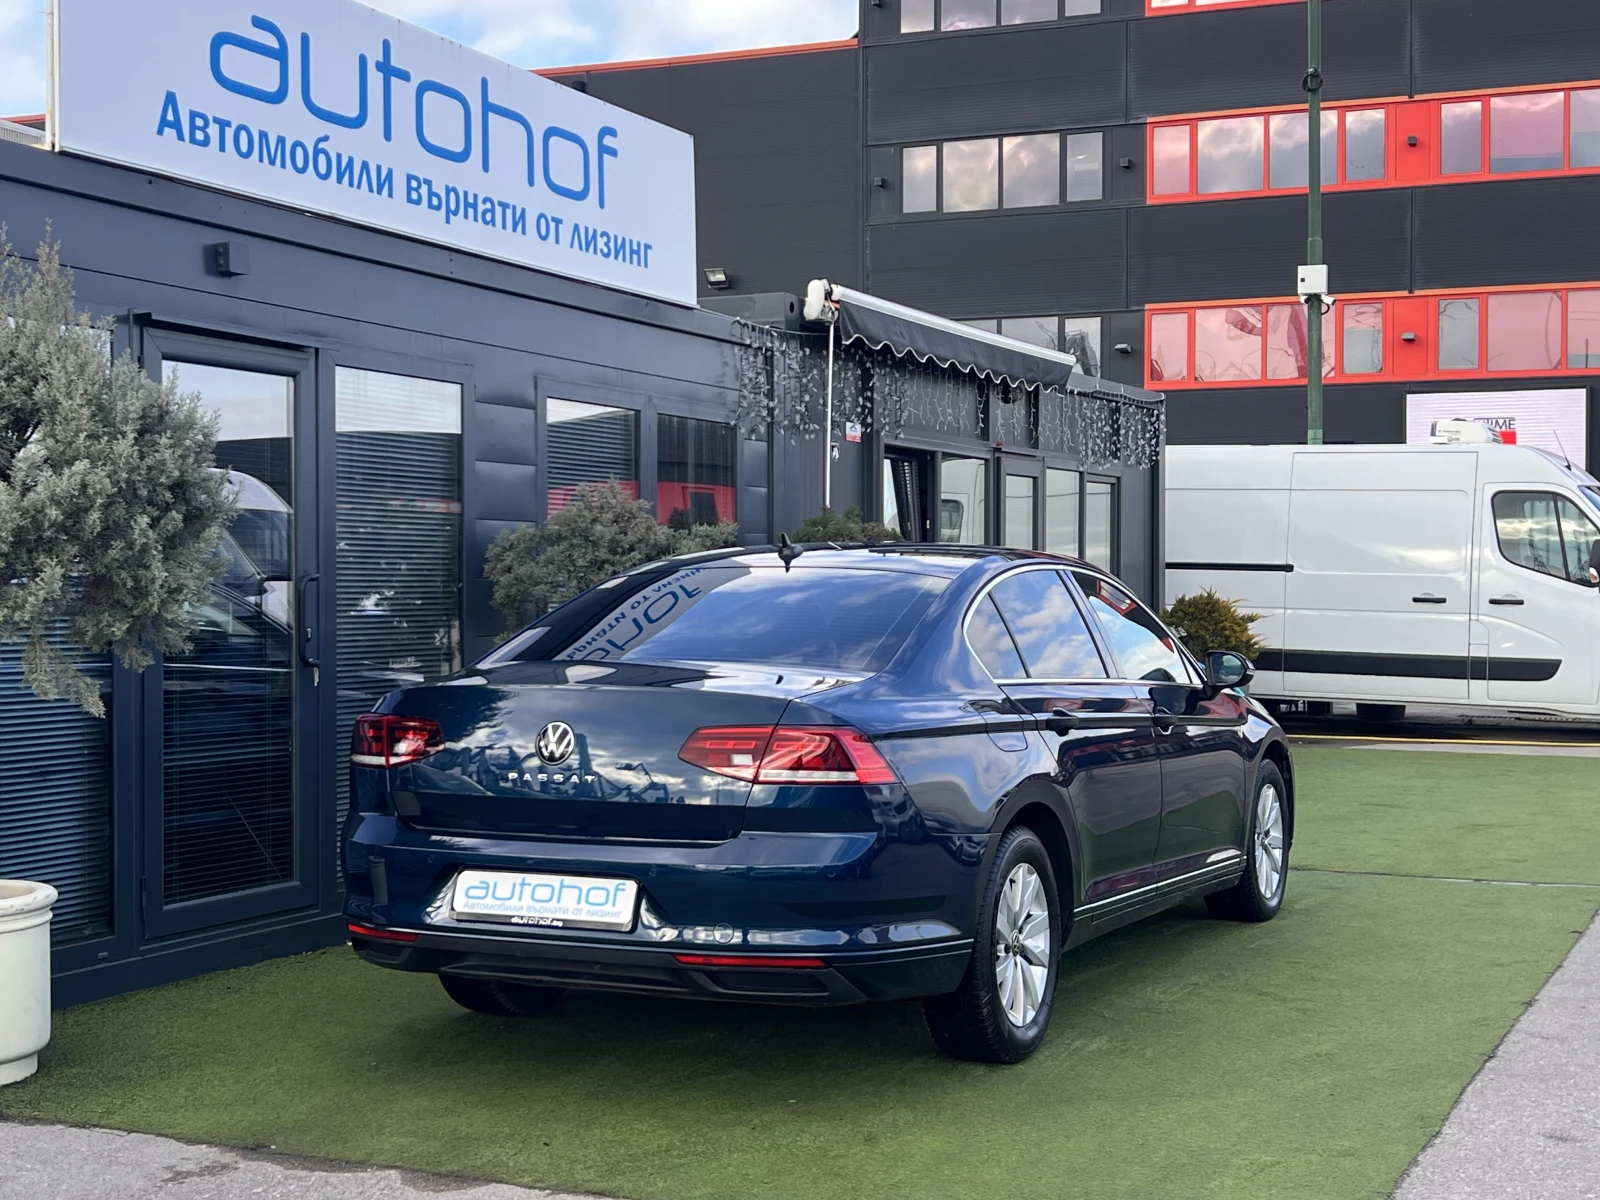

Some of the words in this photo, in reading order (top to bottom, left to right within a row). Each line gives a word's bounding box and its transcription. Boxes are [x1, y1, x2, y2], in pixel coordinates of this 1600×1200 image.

[209, 14, 619, 210] autohof
[156, 90, 395, 200] Автомобили
[406, 172, 527, 237] върнати
[536, 211, 563, 246] от
[569, 221, 653, 270] лизинг
[537, 721, 575, 765] VW
[507, 772, 596, 784] PASSAT
[462, 900, 524, 913] Автомобили
[526, 904, 570, 917] върнати
[572, 908, 583, 917] от
[585, 909, 623, 919] лизинг
[465, 877, 626, 907] autohof
